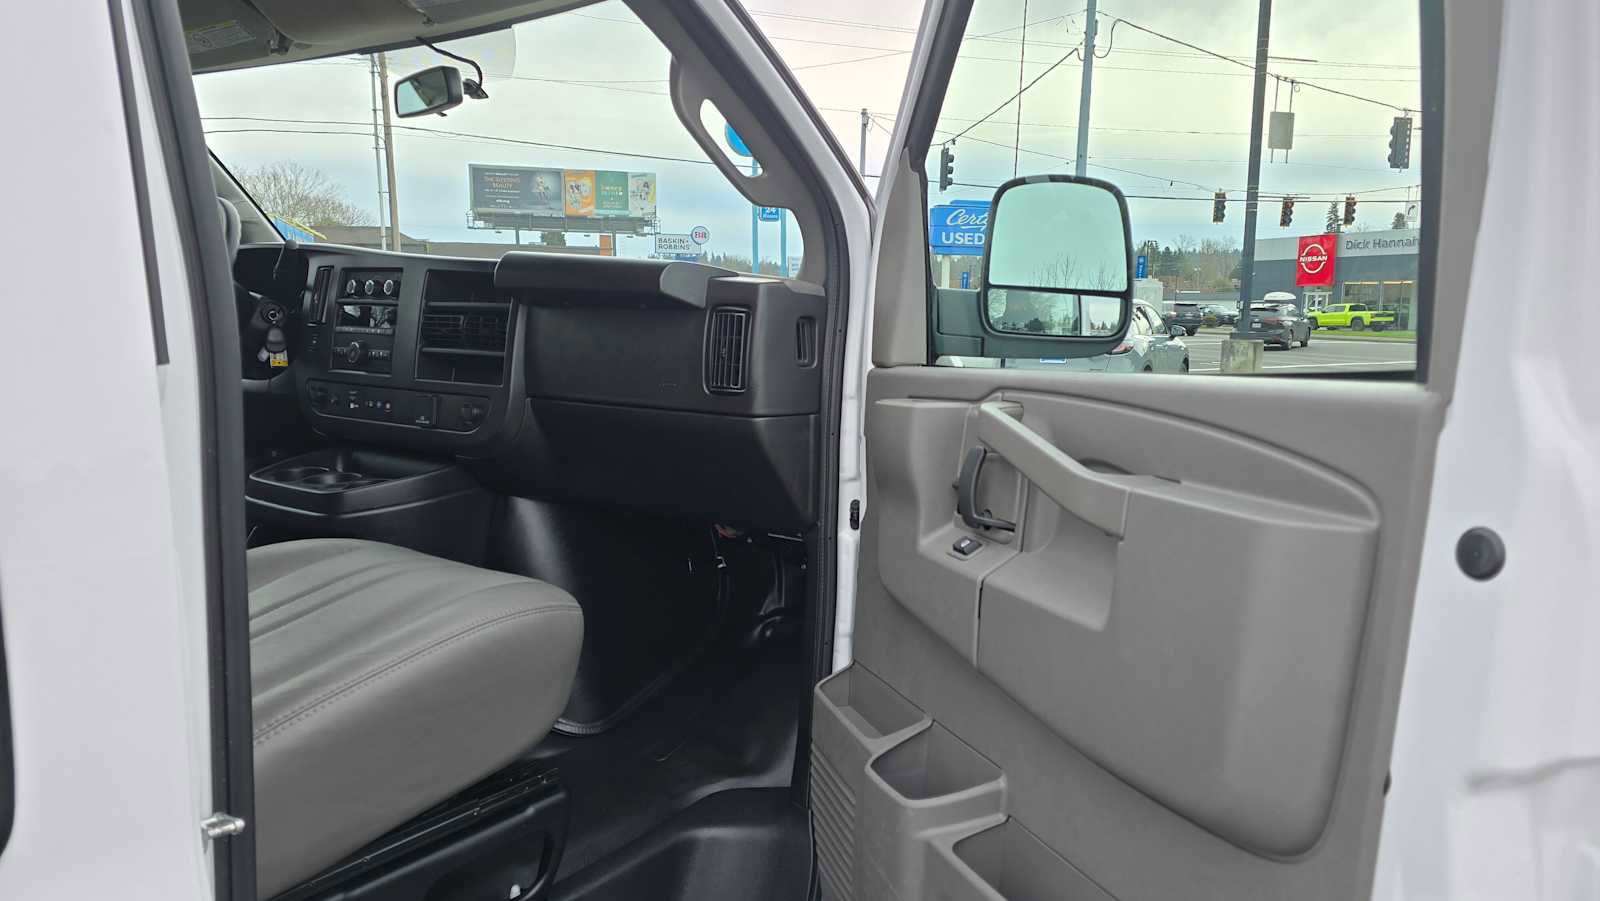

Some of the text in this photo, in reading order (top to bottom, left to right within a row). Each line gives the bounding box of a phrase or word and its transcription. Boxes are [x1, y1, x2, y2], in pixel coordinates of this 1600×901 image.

[946, 209, 989, 230] Cert
[941, 231, 985, 245] USED
[1345, 239, 1370, 249] Dick
